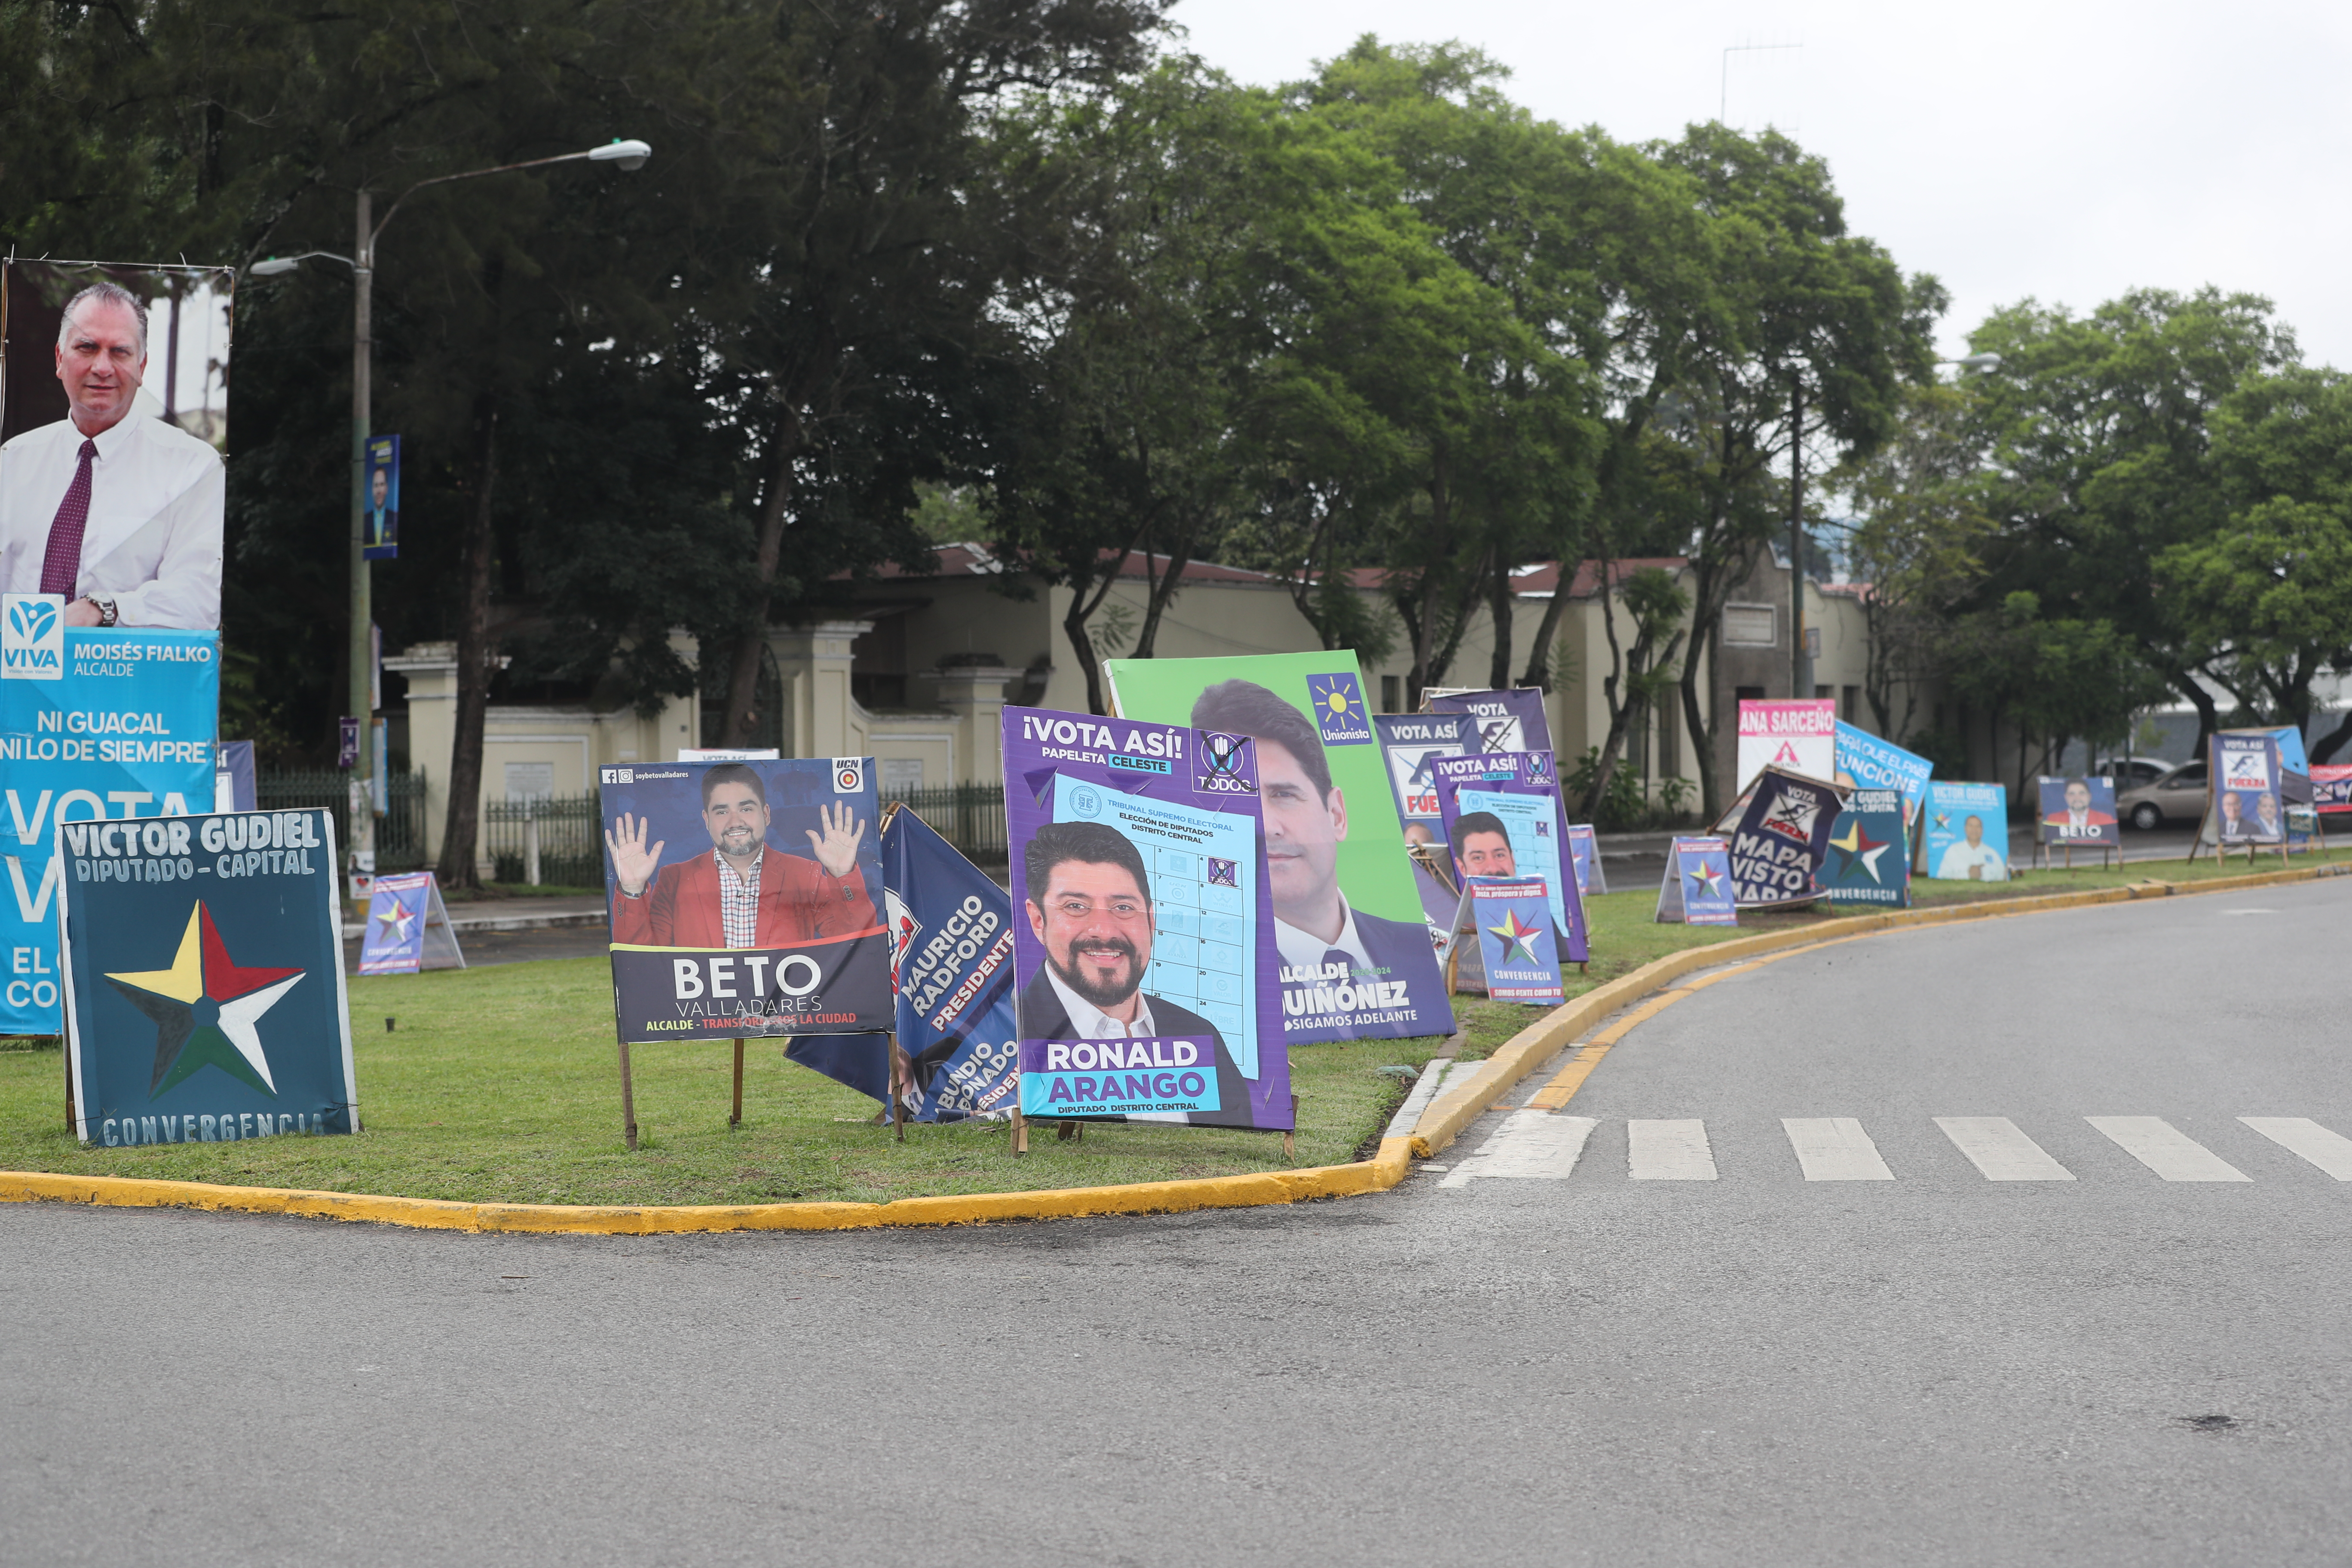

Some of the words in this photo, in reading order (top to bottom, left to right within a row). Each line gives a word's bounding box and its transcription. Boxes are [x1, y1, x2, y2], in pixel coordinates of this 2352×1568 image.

[5, 649, 59, 668] VIVA
[74, 642, 142, 661] MOISÉS
[147, 646, 211, 662] FIALKO
[74, 663, 134, 677] ALCALDE
[1466, 703, 1509, 716] VOTA
[1739, 710, 1768, 732] ANA
[1770, 707, 1834, 732] SARCEÑO
[38, 711, 62, 732] NI
[66, 711, 170, 735] GUACAL
[1390, 725, 1432, 740] VOTA
[1434, 721, 1458, 739] ASÍ
[1023, 715, 1116, 751] ¡VOTA
[1123, 728, 1183, 760] ASÍ!
[1322, 728, 1369, 741] Unionista
[0, 738, 21, 760] NI
[26, 738, 58, 760] LO
[62, 739, 95, 761] DE
[99, 740, 206, 763] SIEMPRE
[1042, 747, 1106, 765] PAPELETA
[1112, 756, 1167, 772] CELESTE
[836, 760, 858, 769] UCN
[1438, 760, 1486, 775] ¡VOTA
[1489, 754, 1518, 772] ASÍ!
[635, 772, 689, 781] soybetovalladares
[1198, 775, 1251, 792] TODOS
[1449, 774, 1482, 783] PAPELETA
[1407, 795, 1440, 813] FUE
[1787, 784, 1816, 803] VOTA
[1857, 791, 1898, 804] GUDIEL
[1107, 799, 1146, 814] TRIBUNAL
[1148, 809, 1186, 822] SUPREMO
[1188, 818, 1234, 831] ELECTORAL
[1119, 812, 1157, 825] ELECCIÓN
[1170, 824, 1213, 837] DIPUTADOS
[64, 821, 191, 858] VICTOR
[200, 813, 320, 854] GUDIEL
[1132, 824, 1166, 836] DISTRITO
[1168, 832, 1203, 843] CENTRAL
[2059, 824, 2102, 838] BETO
[1734, 832, 1813, 873] MAPA
[76, 858, 193, 882] DIPUTADO
[217, 849, 315, 878] CAPITAL
[1732, 856, 1803, 890] VISTO
[1491, 890, 1518, 898] próspera
[901, 896, 982, 1002] MAURICIO
[13, 947, 50, 974] EL
[913, 911, 998, 1017] RADFORD
[674, 955, 821, 999] BETO
[932, 929, 1014, 1032] PRESIDENTE
[1351, 967, 1391, 977] 2020-2024
[1494, 970, 1552, 981] CONVERGENCIA
[675, 995, 822, 1017] VALLADARES
[1282, 979, 1410, 1017] UIÑÓNEZ
[646, 1020, 693, 1031] ALCALDE
[800, 1014, 813, 1024] LA
[815, 1013, 856, 1023] CIUDAD
[1292, 1014, 1352, 1030] SIGAMOS
[1355, 1010, 1418, 1025] ADELANTE
[1047, 1041, 1198, 1069] RONALD
[935, 1043, 992, 1115] BUNDIO
[1048, 1072, 1206, 1103] ARANGO
[1058, 1104, 1106, 1113] DIPUTADO
[1111, 1103, 1153, 1112] DISTRITO
[1155, 1102, 1199, 1111] CENTRAL
[104, 1113, 324, 1147] CONVERGENCIA
